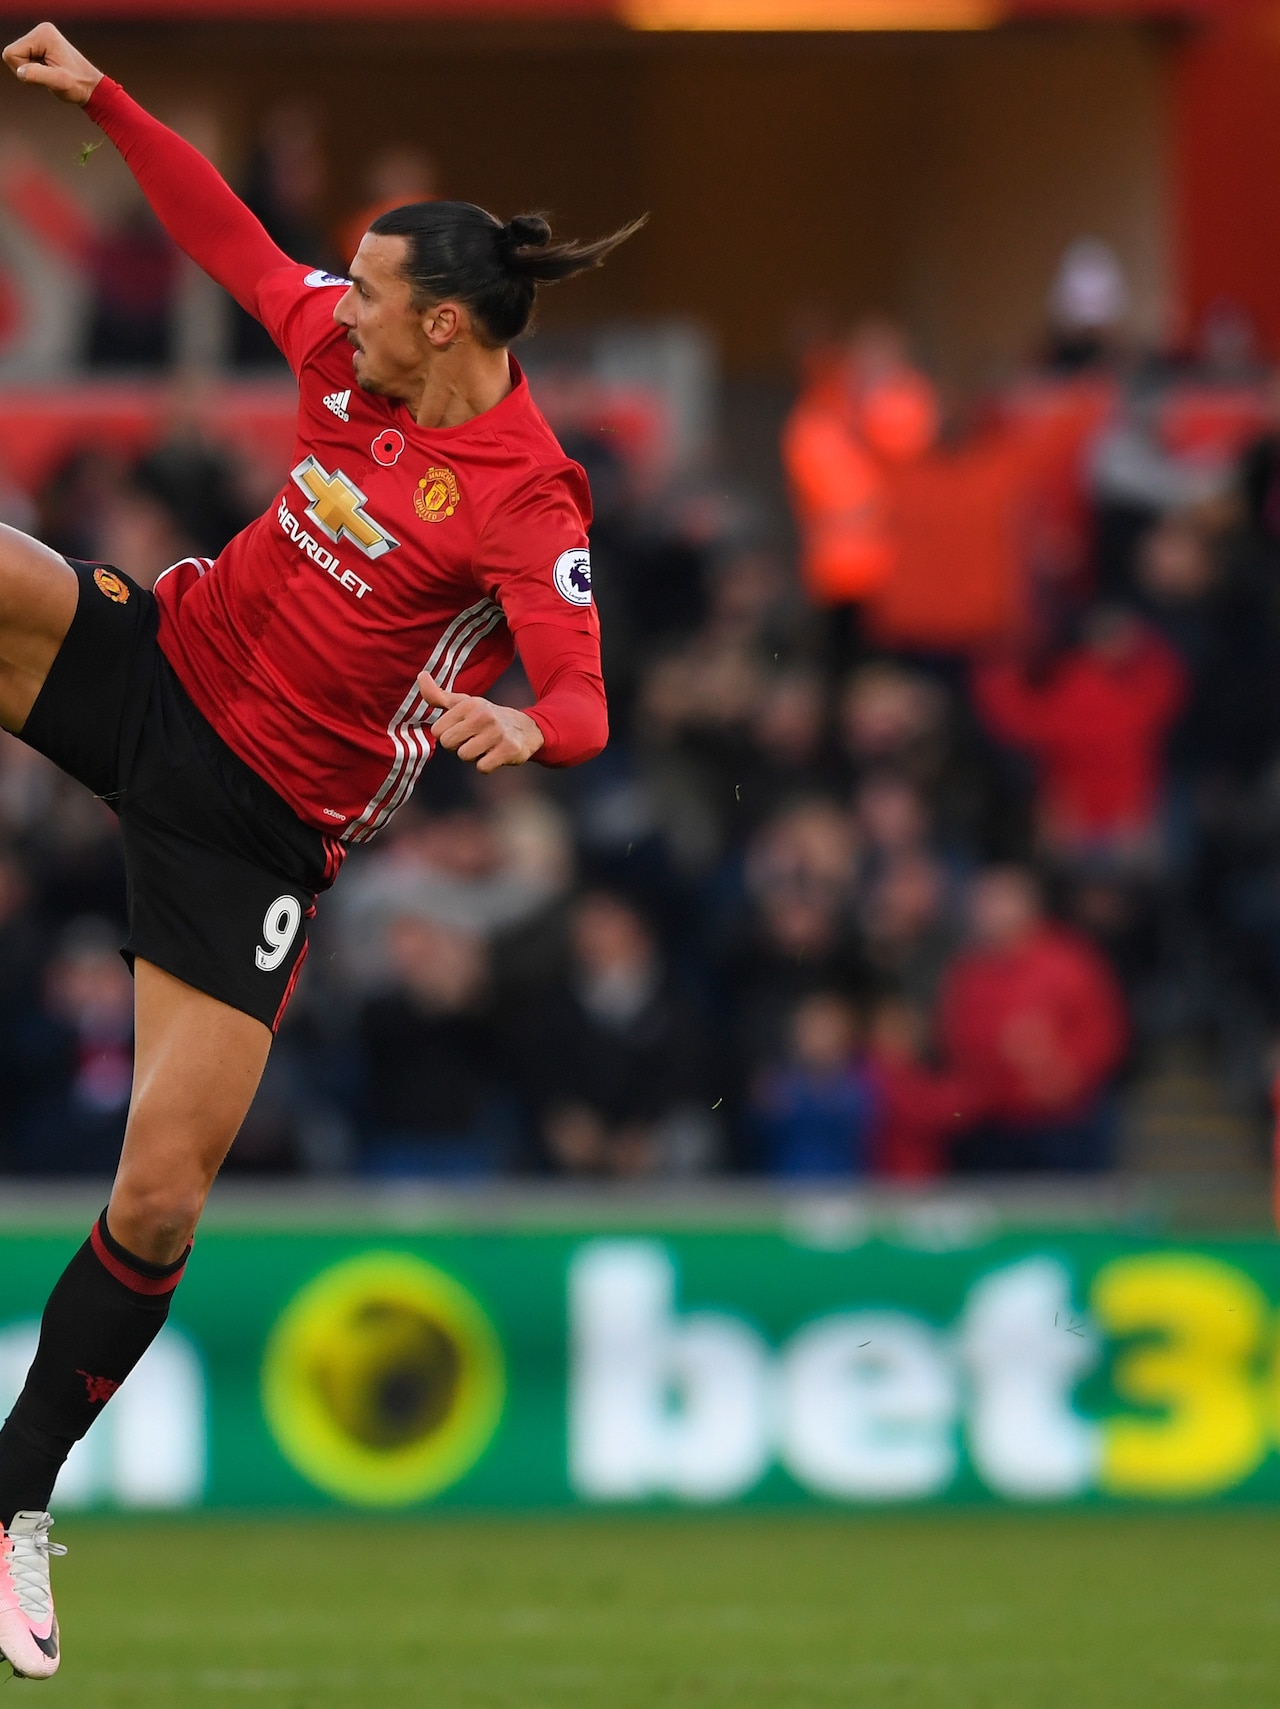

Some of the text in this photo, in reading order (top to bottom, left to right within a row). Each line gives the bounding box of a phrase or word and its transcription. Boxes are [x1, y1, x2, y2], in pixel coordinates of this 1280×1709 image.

[322, 395, 350, 423] adidas
[428, 470, 457, 503] MANCHESTER
[415, 498, 438, 520] UNITED
[322, 807, 347, 821] adizero
[255, 894, 302, 972] 9
[566, 1236, 1280, 1504] bet3
